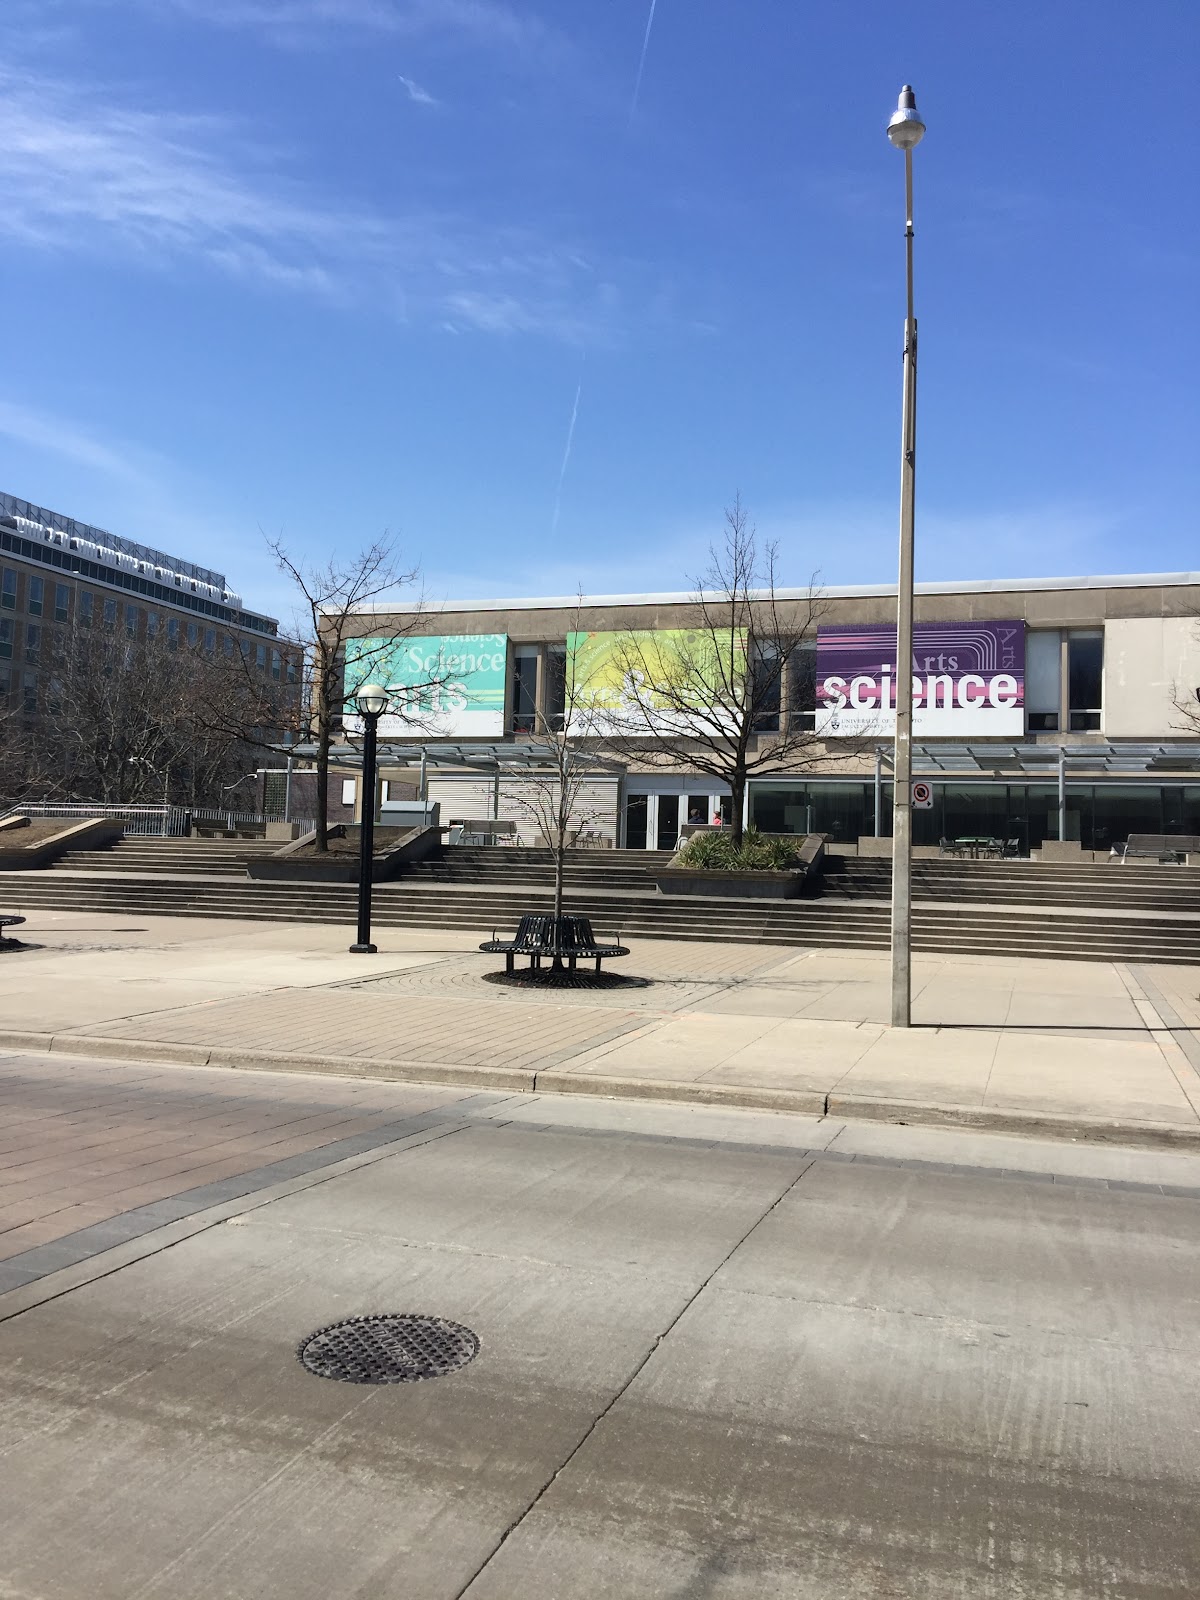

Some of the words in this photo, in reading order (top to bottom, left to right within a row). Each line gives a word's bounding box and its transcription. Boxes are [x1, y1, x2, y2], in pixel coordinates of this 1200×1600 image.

[408, 646, 504, 673] Science
[995, 626, 1018, 669] Arts
[388, 676, 468, 712] arts
